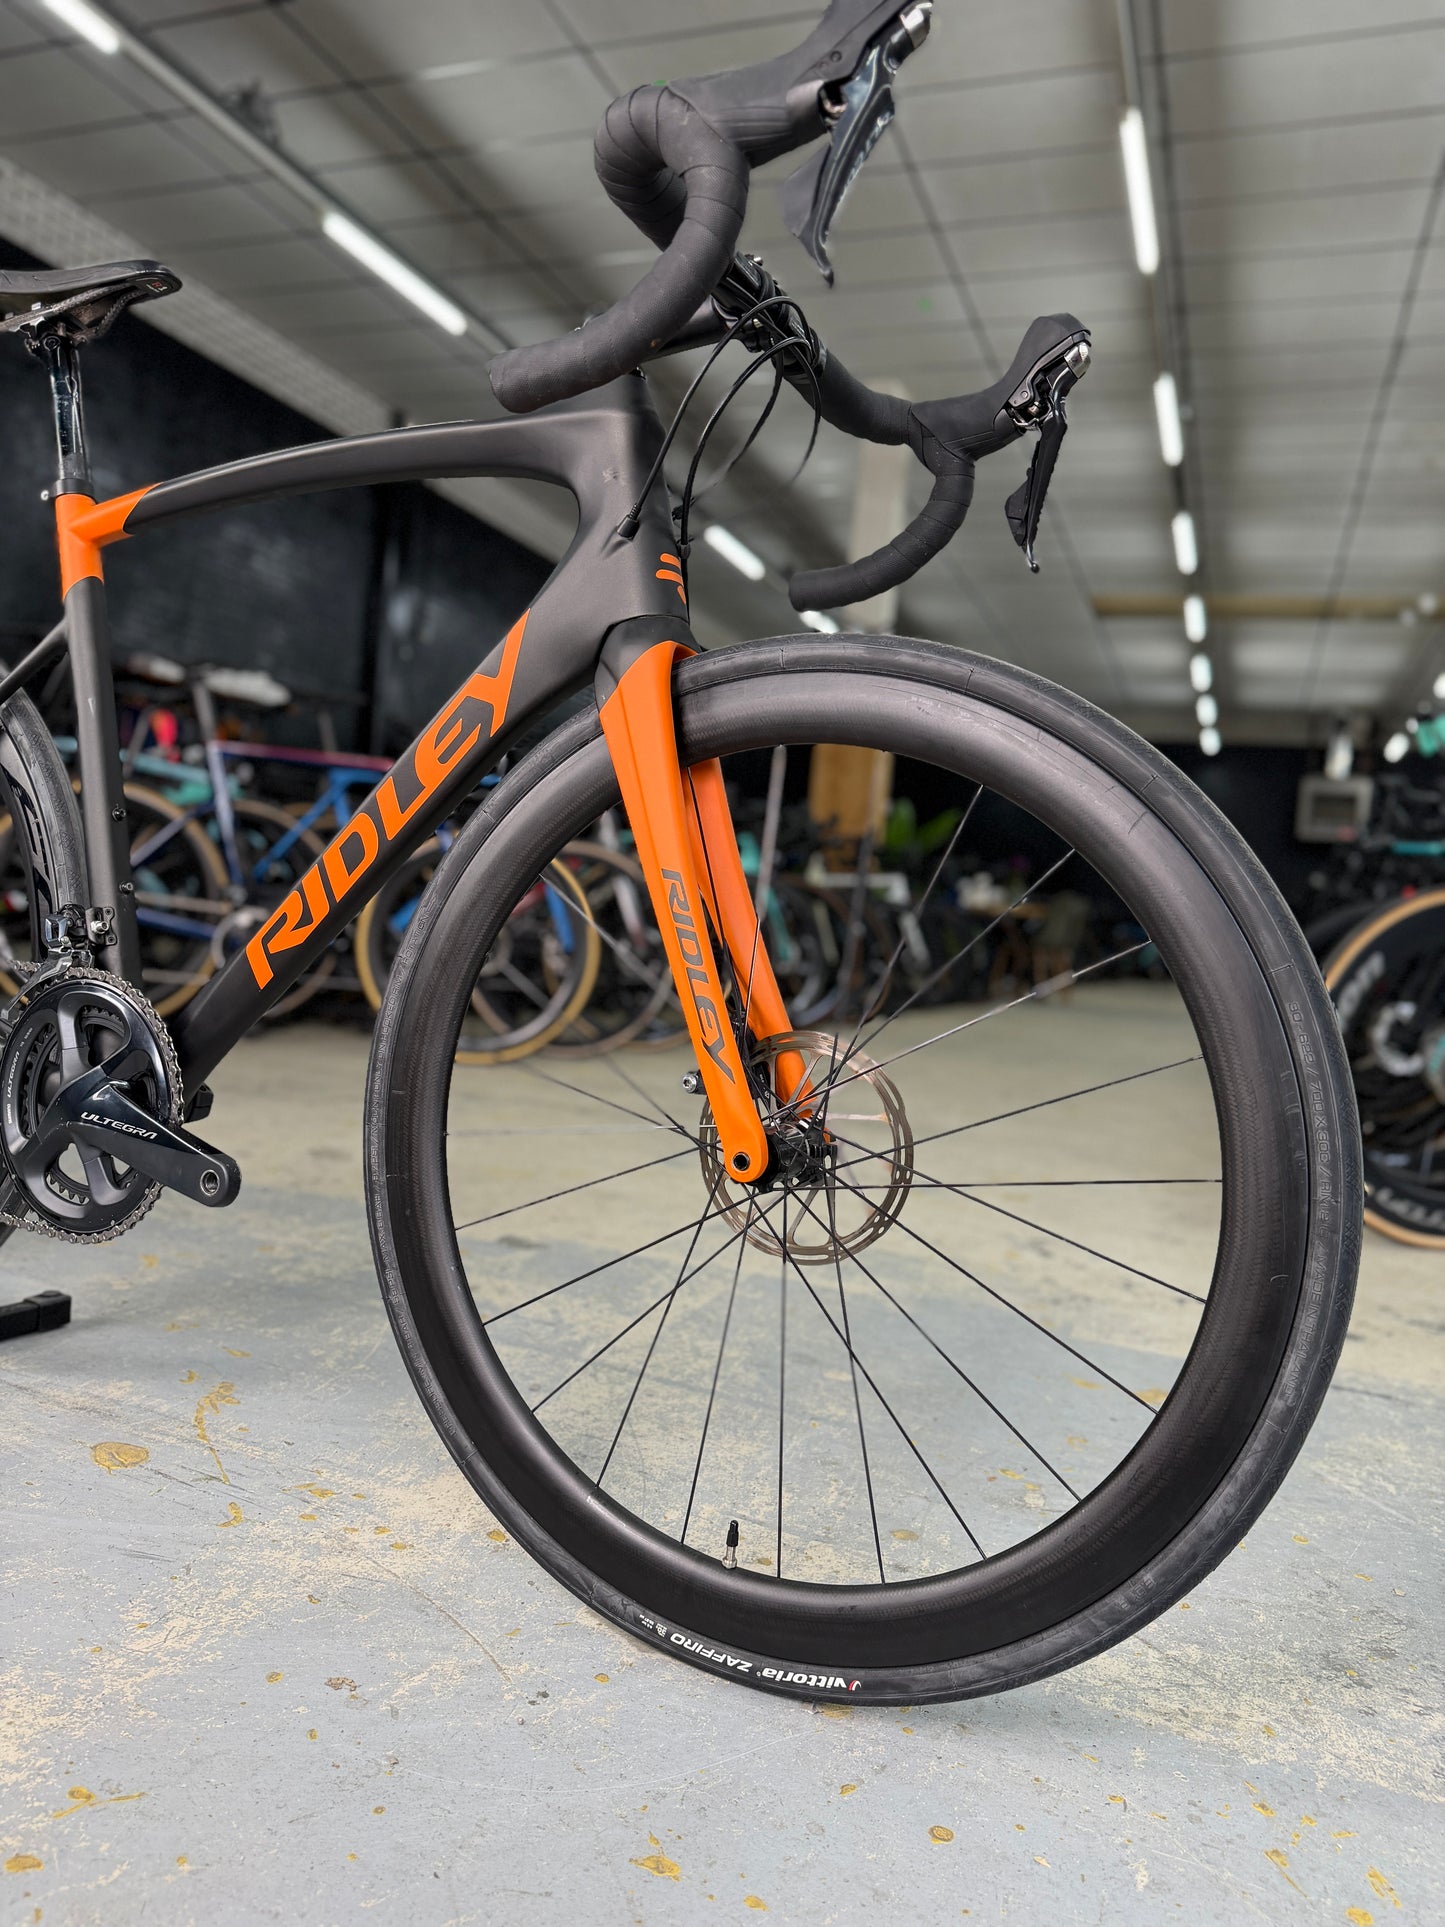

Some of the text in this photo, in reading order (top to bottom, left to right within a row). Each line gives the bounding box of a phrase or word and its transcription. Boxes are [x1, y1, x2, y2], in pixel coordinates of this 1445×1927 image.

[246, 609, 530, 990] RIDLEY
[661, 867, 736, 1084] RIDLEY
[1308, 1079, 1326, 1112] 700
[80, 1111, 158, 1140] ULTEGRA
[1310, 1255, 1327, 1302] MADE
[1306, 1303, 1322, 1320] IN
[1284, 1323, 1314, 1396] THAILAND
[670, 1632, 753, 1672] ZAFFIRO
